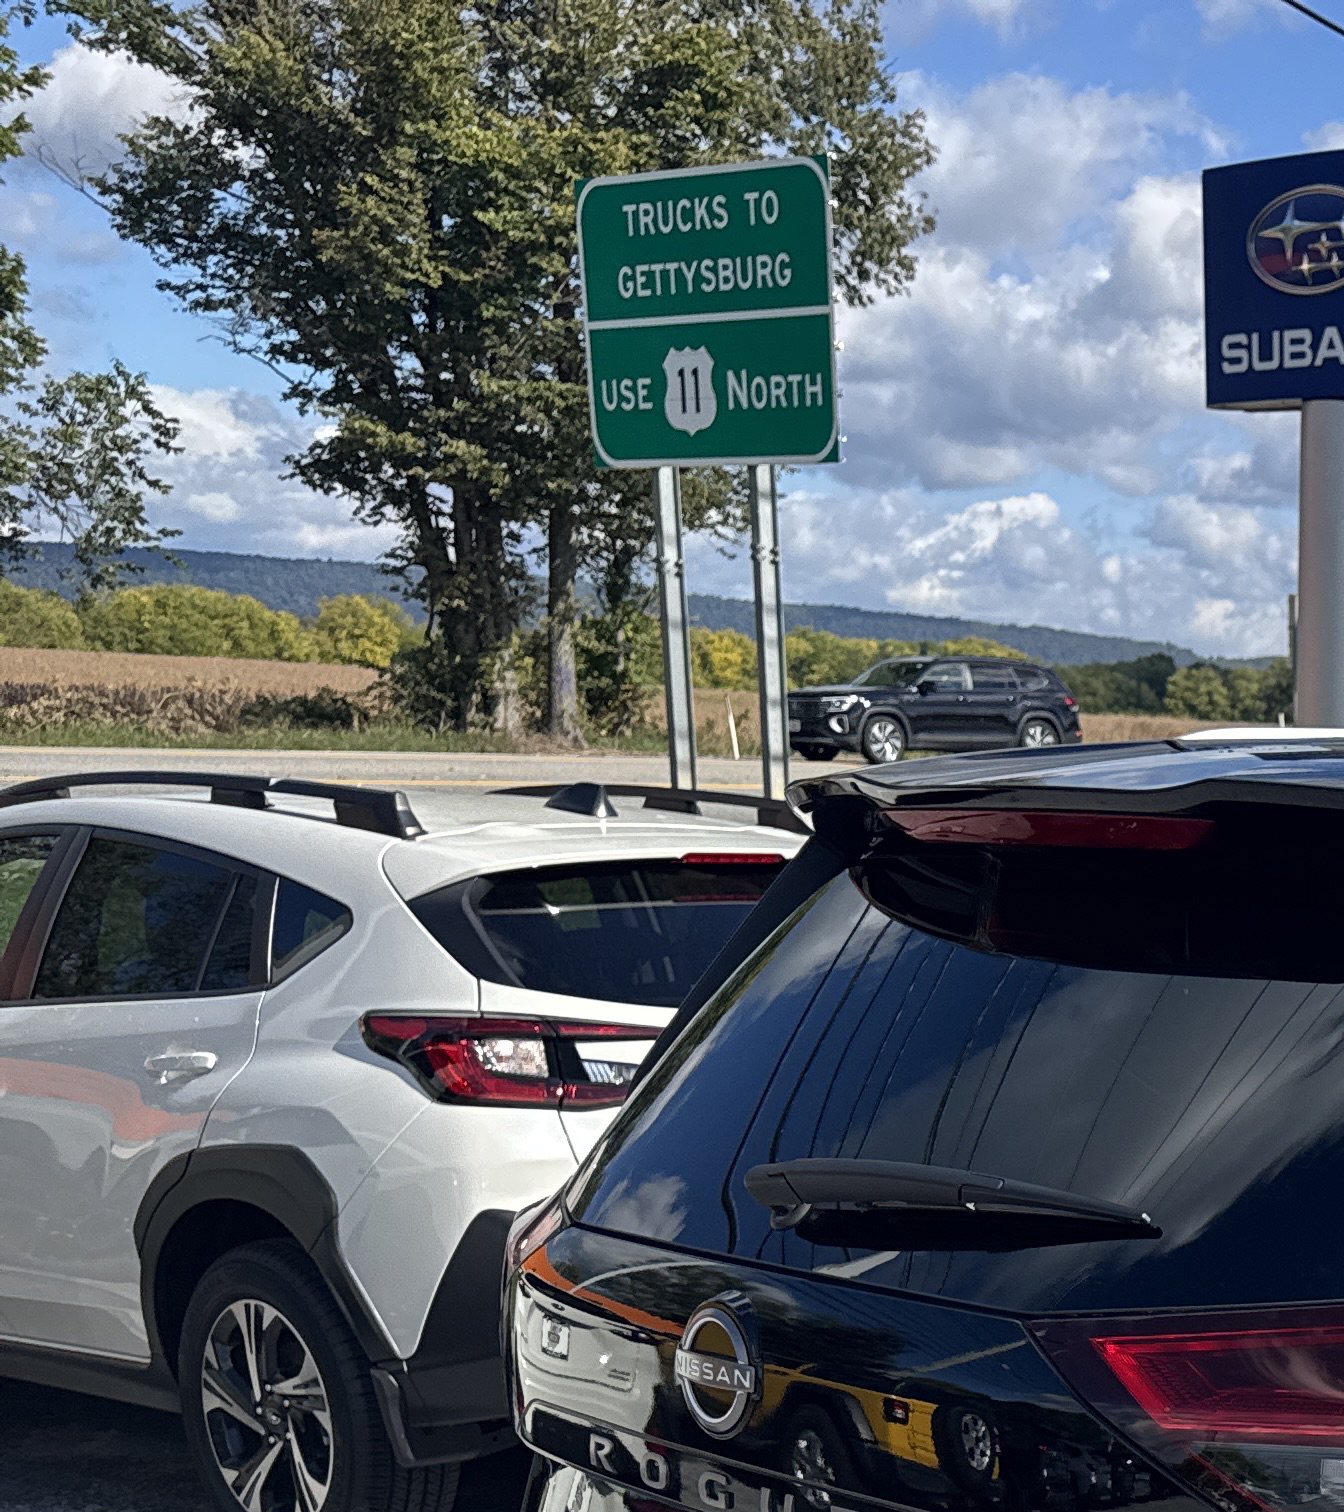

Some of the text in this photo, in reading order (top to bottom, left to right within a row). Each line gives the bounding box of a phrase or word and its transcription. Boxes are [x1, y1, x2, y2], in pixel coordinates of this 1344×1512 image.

[621, 189, 780, 237] TRUCKS TO
[617, 251, 793, 299] GETTYSBURG
[600, 365, 824, 415] USE 11 NORTH
[676, 1352, 751, 1389] NISSAN
